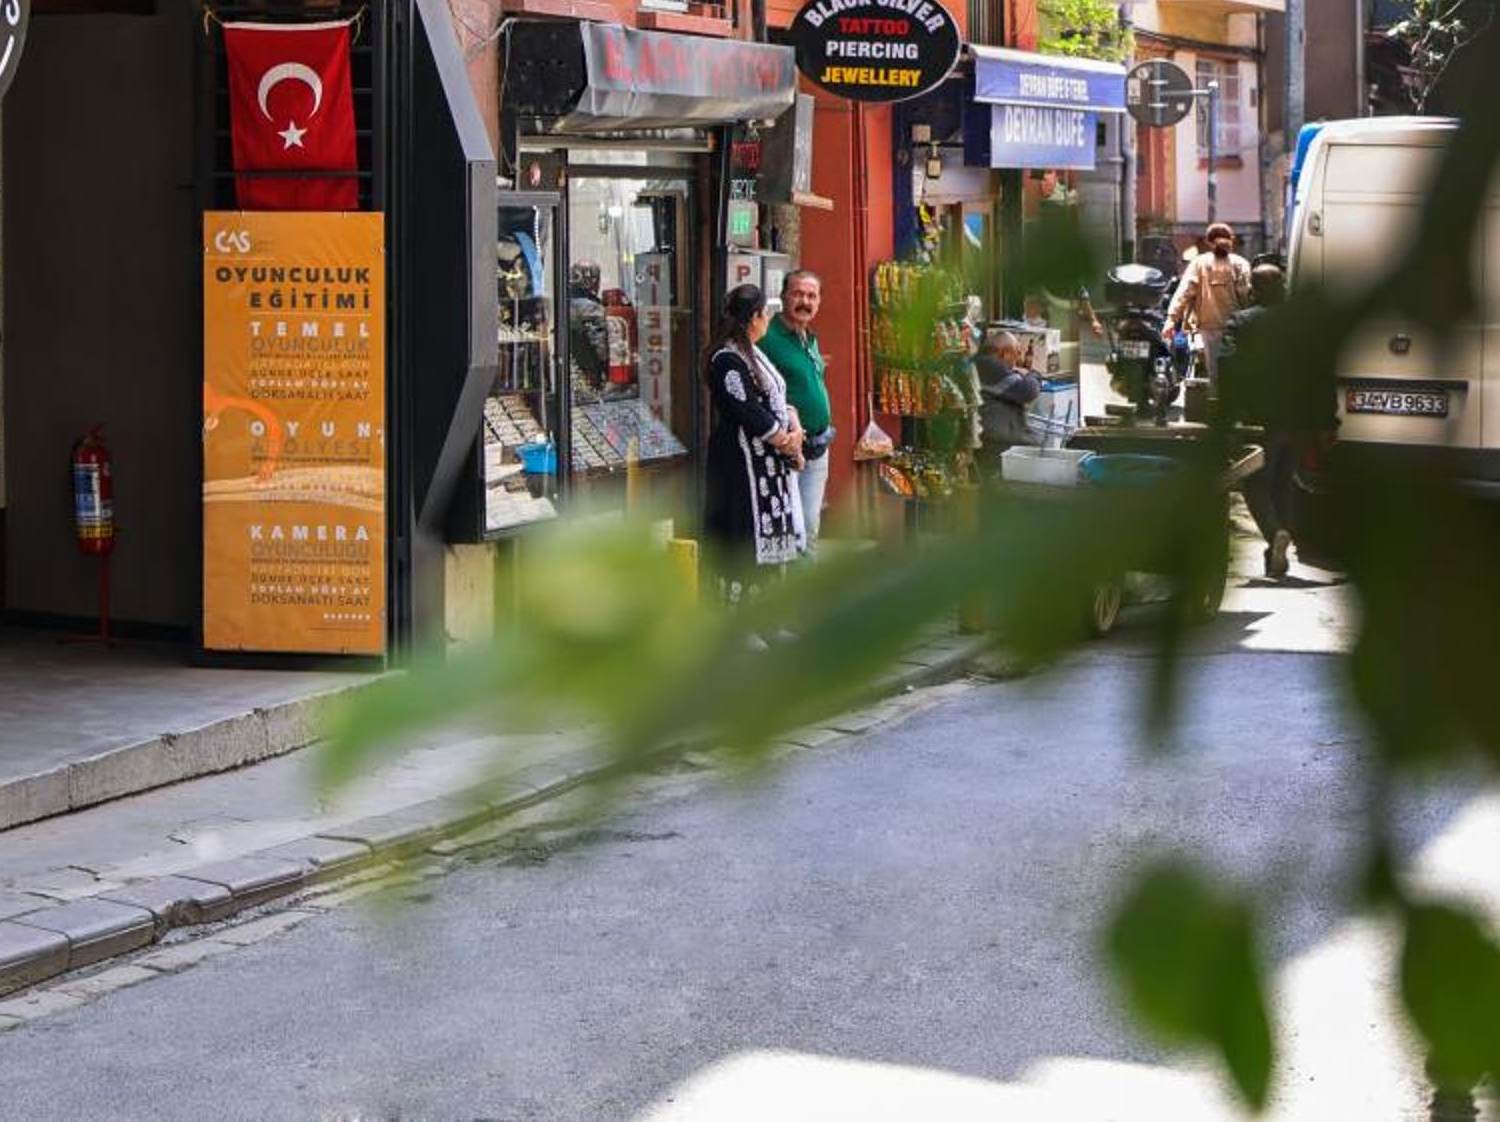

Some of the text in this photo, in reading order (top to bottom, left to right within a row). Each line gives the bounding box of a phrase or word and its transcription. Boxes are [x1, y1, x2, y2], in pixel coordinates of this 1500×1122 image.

[838, 17, 909, 36] TATTOO
[825, 40, 919, 59] PIERCING
[820, 66, 922, 88] JEWELLERY
[216, 267, 370, 284] OYUNCULUK
[250, 288, 370, 309] EĞİTİMİ
[250, 321, 370, 337] TEMEL
[1404, 394, 1445, 411] 9633
[250, 421, 371, 437] OYUN
[251, 525, 369, 541] KAMERA
